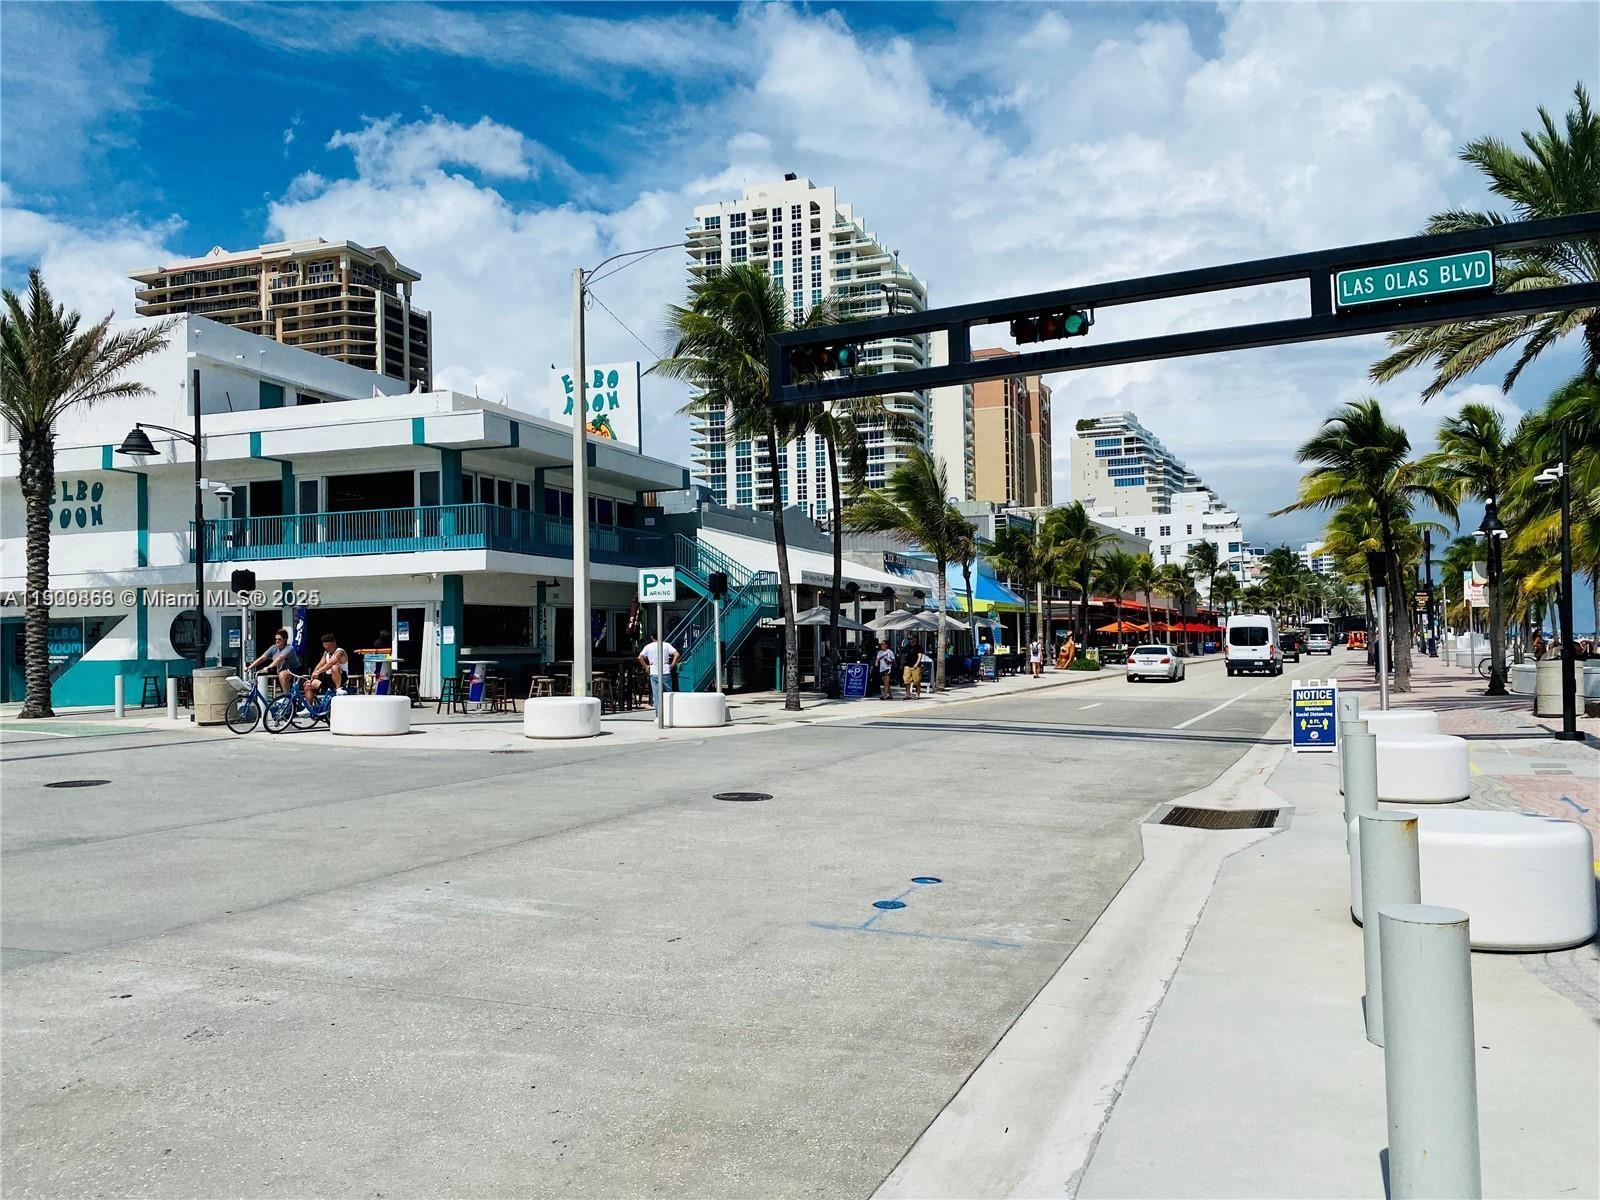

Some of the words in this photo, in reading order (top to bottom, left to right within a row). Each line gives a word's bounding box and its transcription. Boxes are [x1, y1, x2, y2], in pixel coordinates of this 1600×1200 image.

[1343, 276, 1375, 298] LAS
[1384, 269, 1429, 291] OLAS
[1440, 260, 1486, 284] BLVD
[1296, 690, 1332, 700] NOTICE
